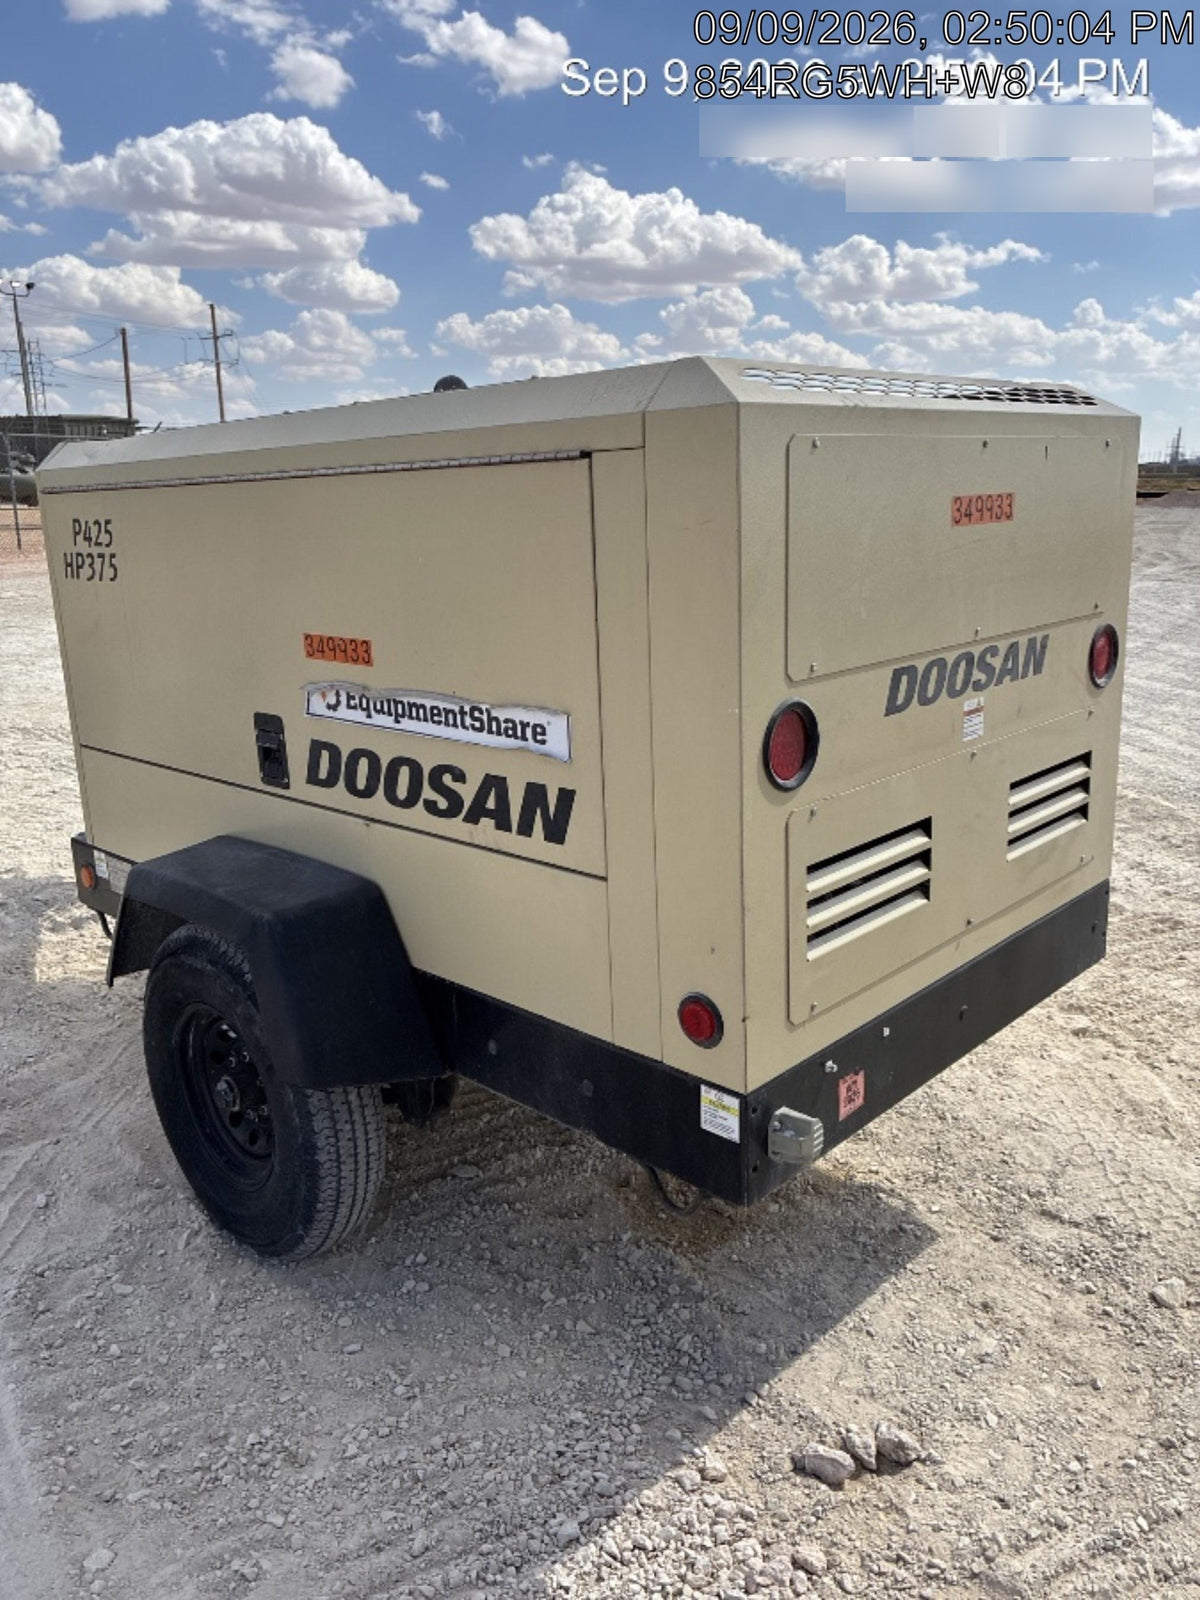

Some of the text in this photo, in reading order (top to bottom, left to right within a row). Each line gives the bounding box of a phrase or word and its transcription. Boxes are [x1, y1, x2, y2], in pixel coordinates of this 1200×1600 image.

[953, 494, 1012, 524] 349933
[72, 518, 113, 548] P425
[64, 552, 118, 582] HP375
[304, 634, 371, 664] 349933
[884, 634, 1049, 717] DOOSAN
[346, 691, 547, 745] EquipmentShare
[306, 738, 576, 845] DOOSAN
